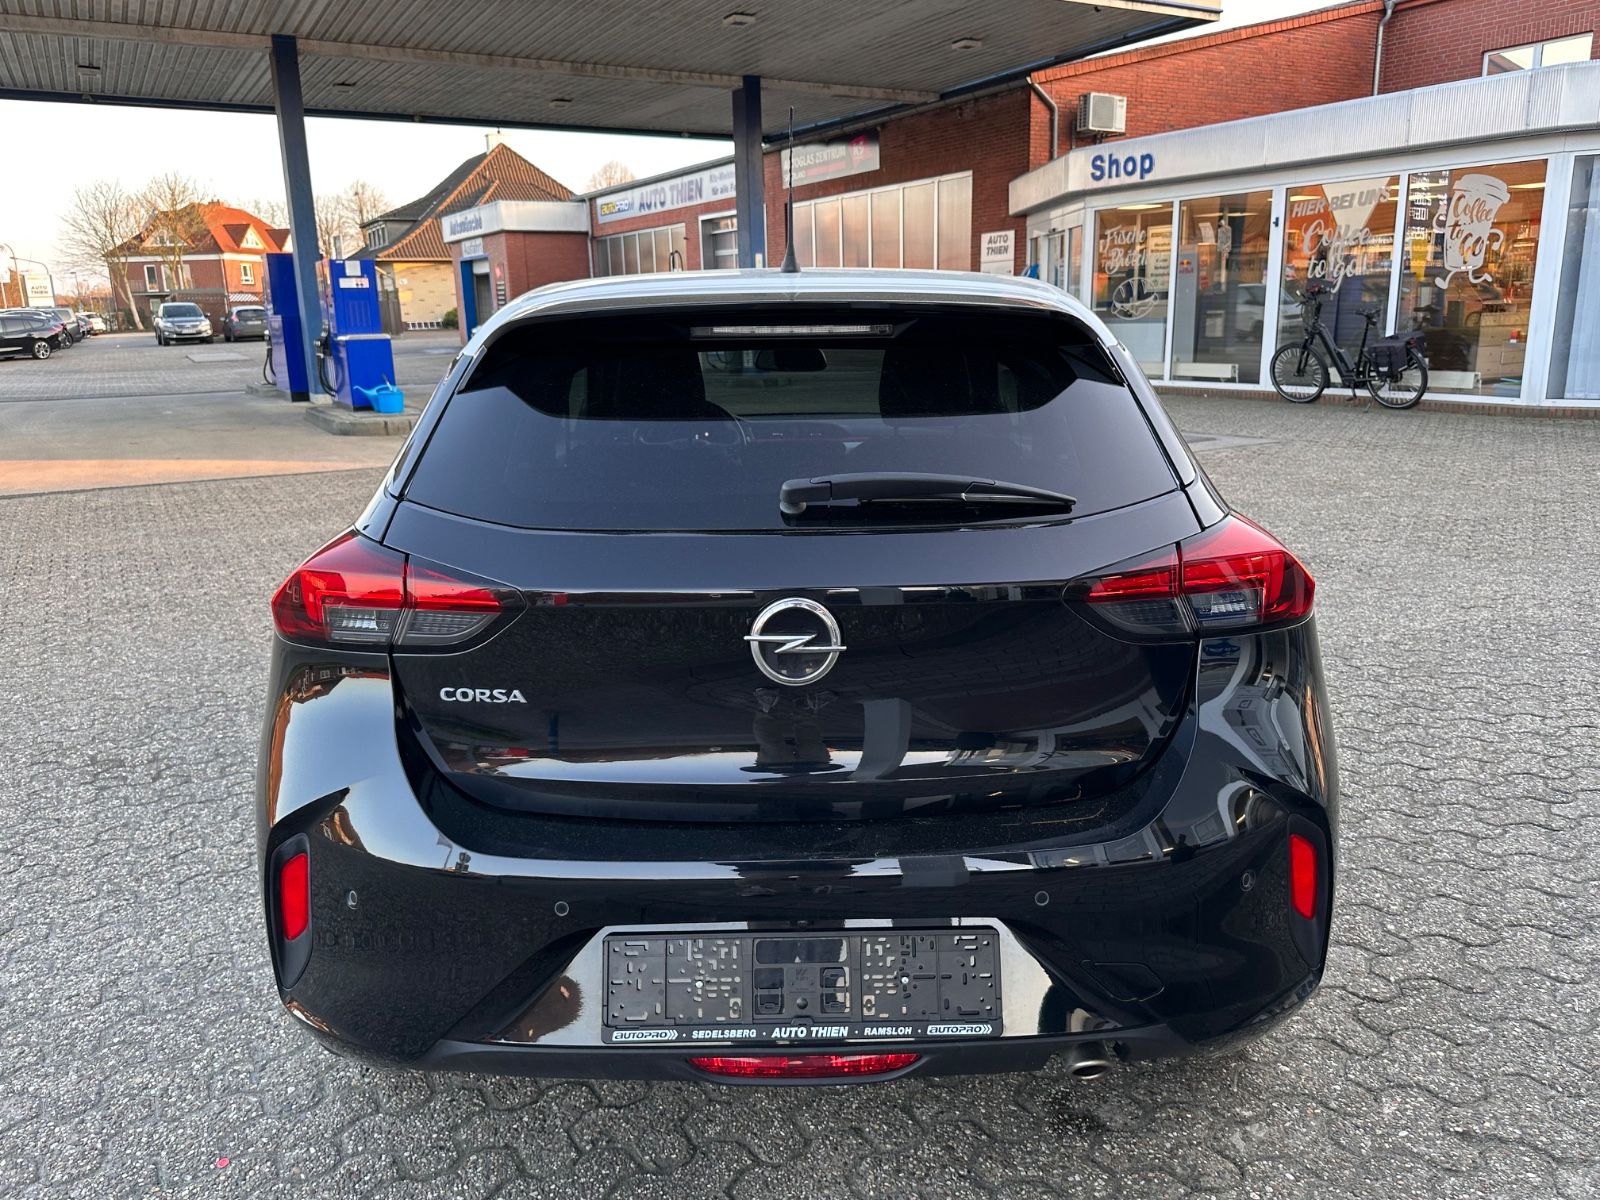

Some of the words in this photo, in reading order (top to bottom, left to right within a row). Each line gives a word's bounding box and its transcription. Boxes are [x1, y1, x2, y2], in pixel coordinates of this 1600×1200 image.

[815, 144, 847, 164] ZENTRUM
[1091, 152, 1155, 182] Shop
[638, 187, 666, 213] AUTO
[669, 177, 704, 206] THIEN
[1291, 199, 1326, 218] HIER
[1329, 191, 1356, 212] BEI
[1357, 187, 1391, 206] UNS
[1452, 193, 1495, 225] Coffee
[987, 234, 1009, 246] AUTO
[1100, 224, 1147, 254] Frische
[1302, 218, 1371, 263] Coffee
[1447, 219, 1463, 241] to
[986, 245, 1009, 257] THIEN
[1307, 255, 1327, 279] to
[439, 687, 528, 704] CORSA
[691, 1029, 757, 1039] SEDELSBERG
[771, 1026, 807, 1039] AUTO
[810, 1026, 849, 1038] THIEN
[863, 1026, 913, 1036] RAMSLOH
